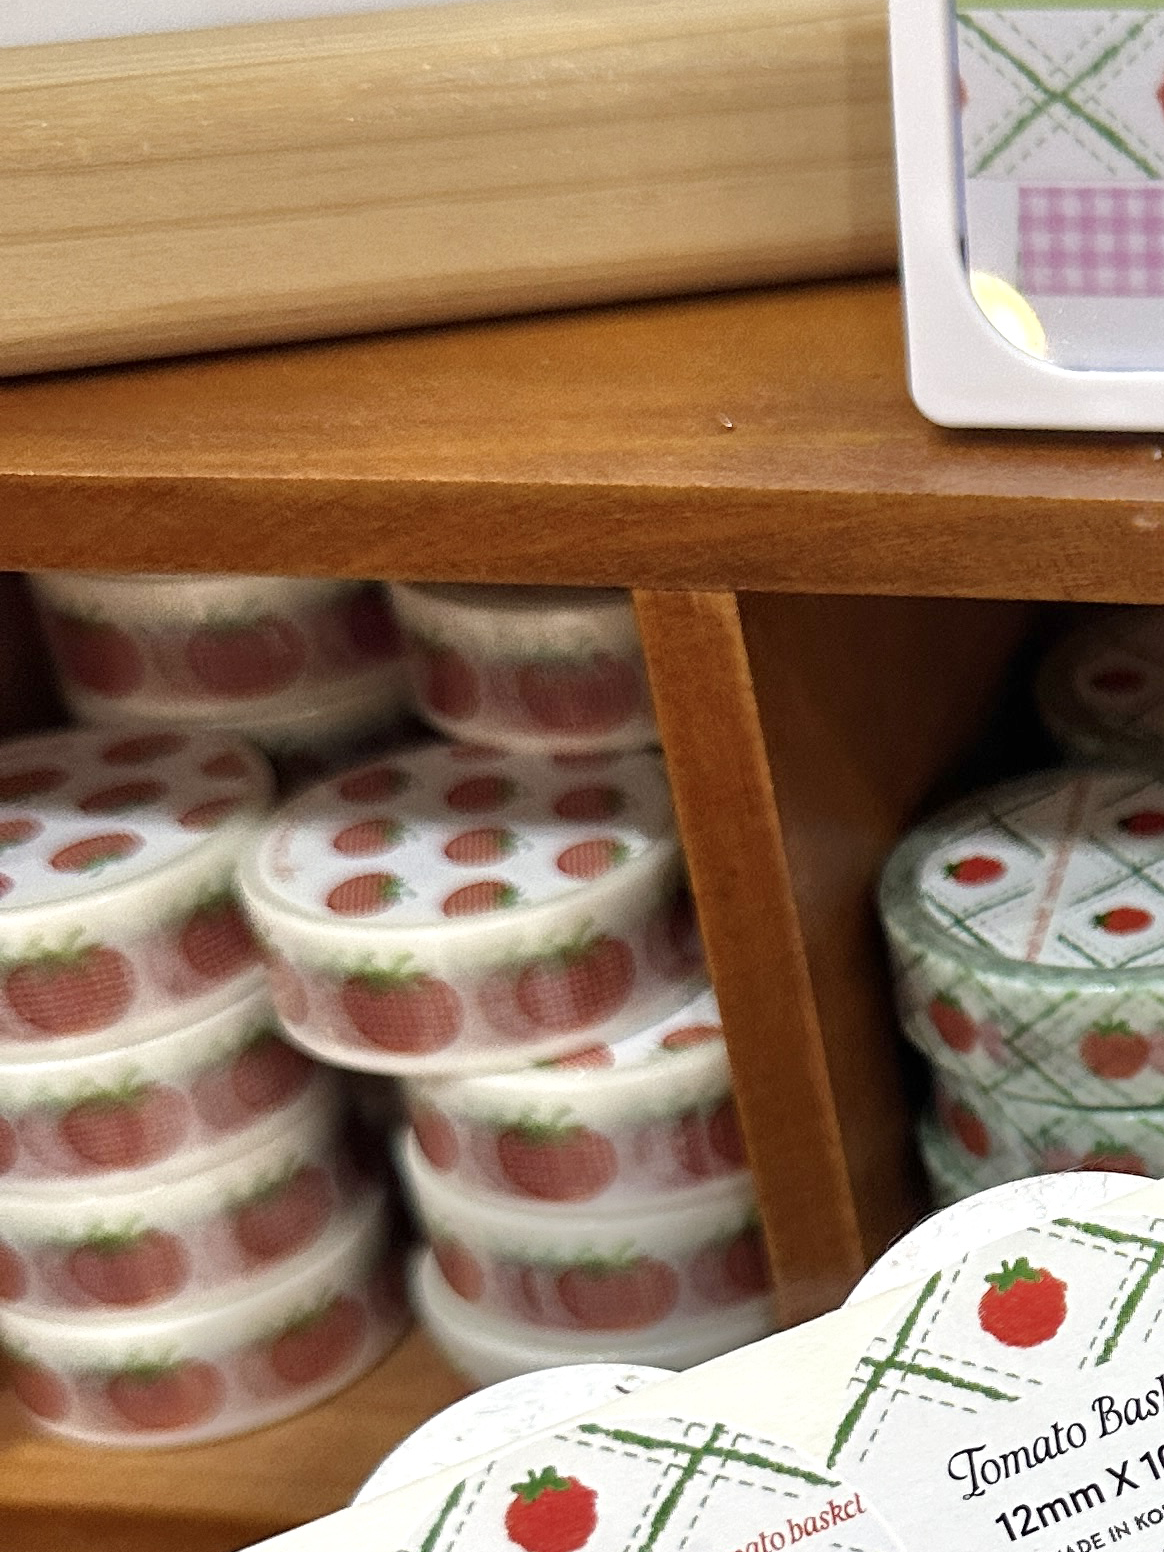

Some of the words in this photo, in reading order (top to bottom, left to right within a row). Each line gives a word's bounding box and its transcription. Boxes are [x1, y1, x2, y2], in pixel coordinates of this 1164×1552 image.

[947, 1421, 1087, 1500] Tomato
[788, 1492, 868, 1544] basket
[994, 1479, 1106, 1543] 12mm
[1105, 1459, 1141, 1498] X
[1108, 1523, 1131, 1542] IN
